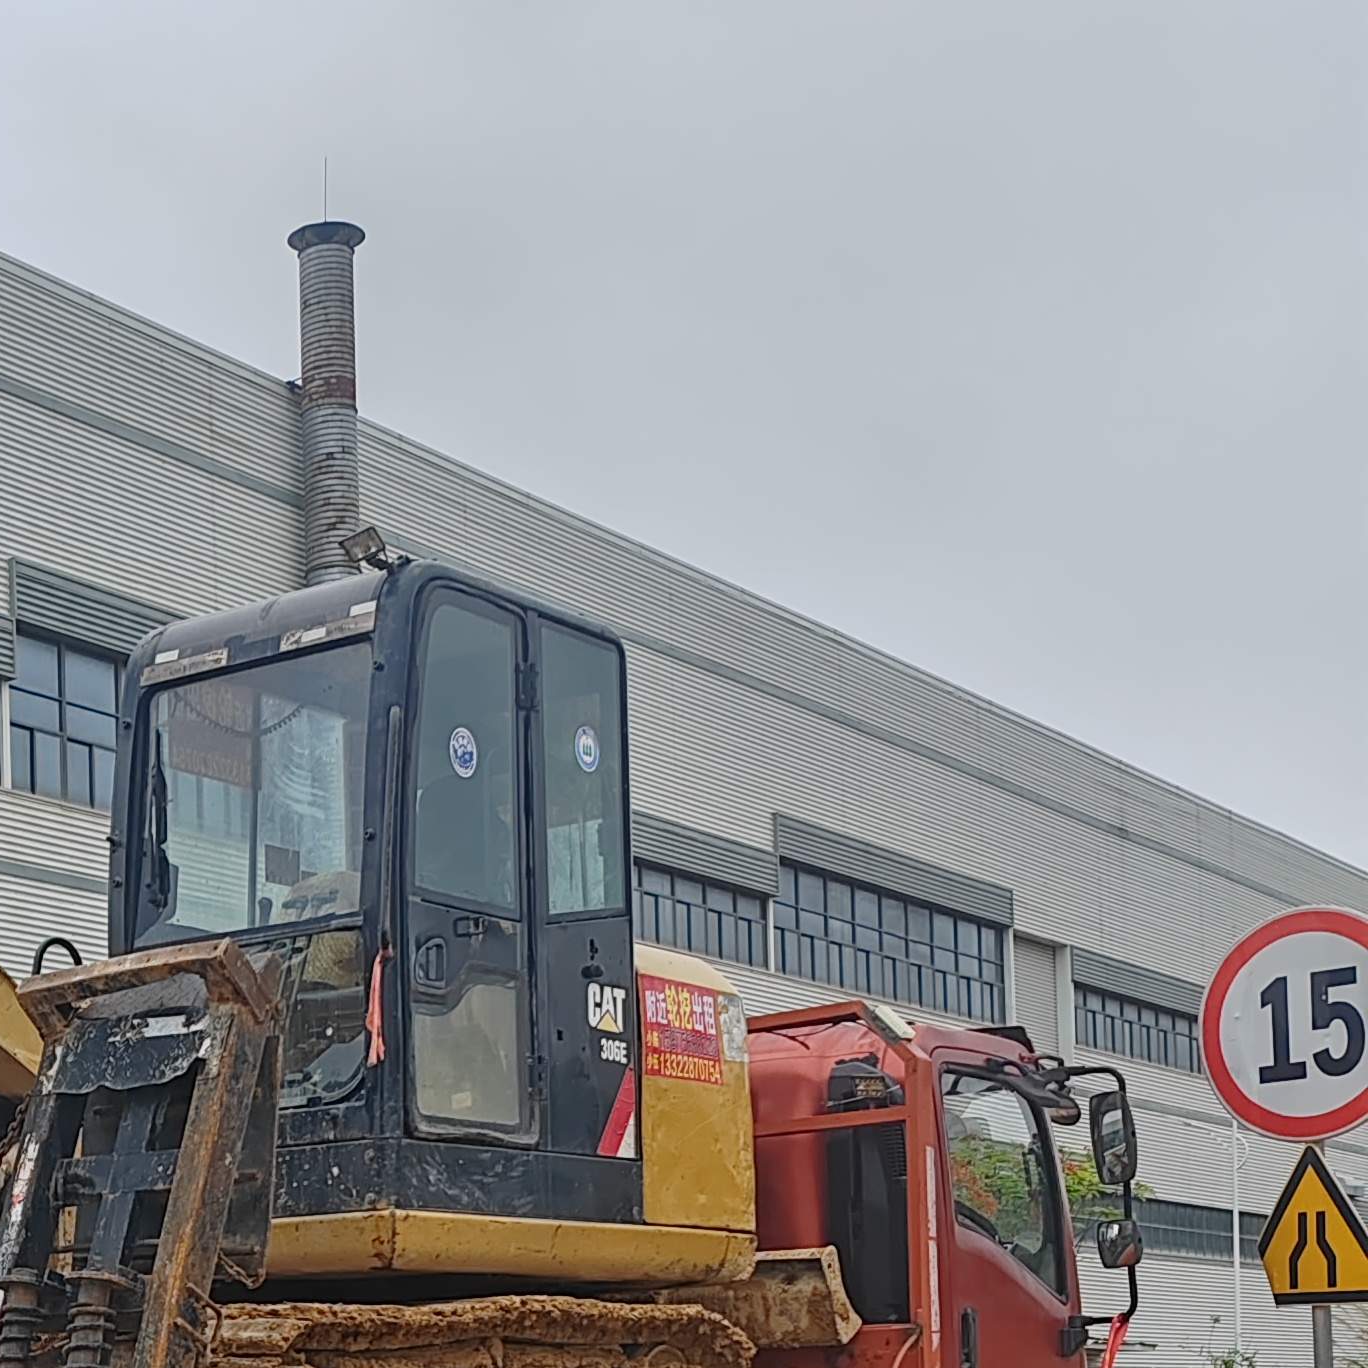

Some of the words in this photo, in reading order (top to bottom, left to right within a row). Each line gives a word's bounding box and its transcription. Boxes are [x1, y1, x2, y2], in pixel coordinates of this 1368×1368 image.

[587, 982, 626, 1033] CAT
[1259, 966, 1365, 1084] 15
[600, 1038, 627, 1064] 306E
